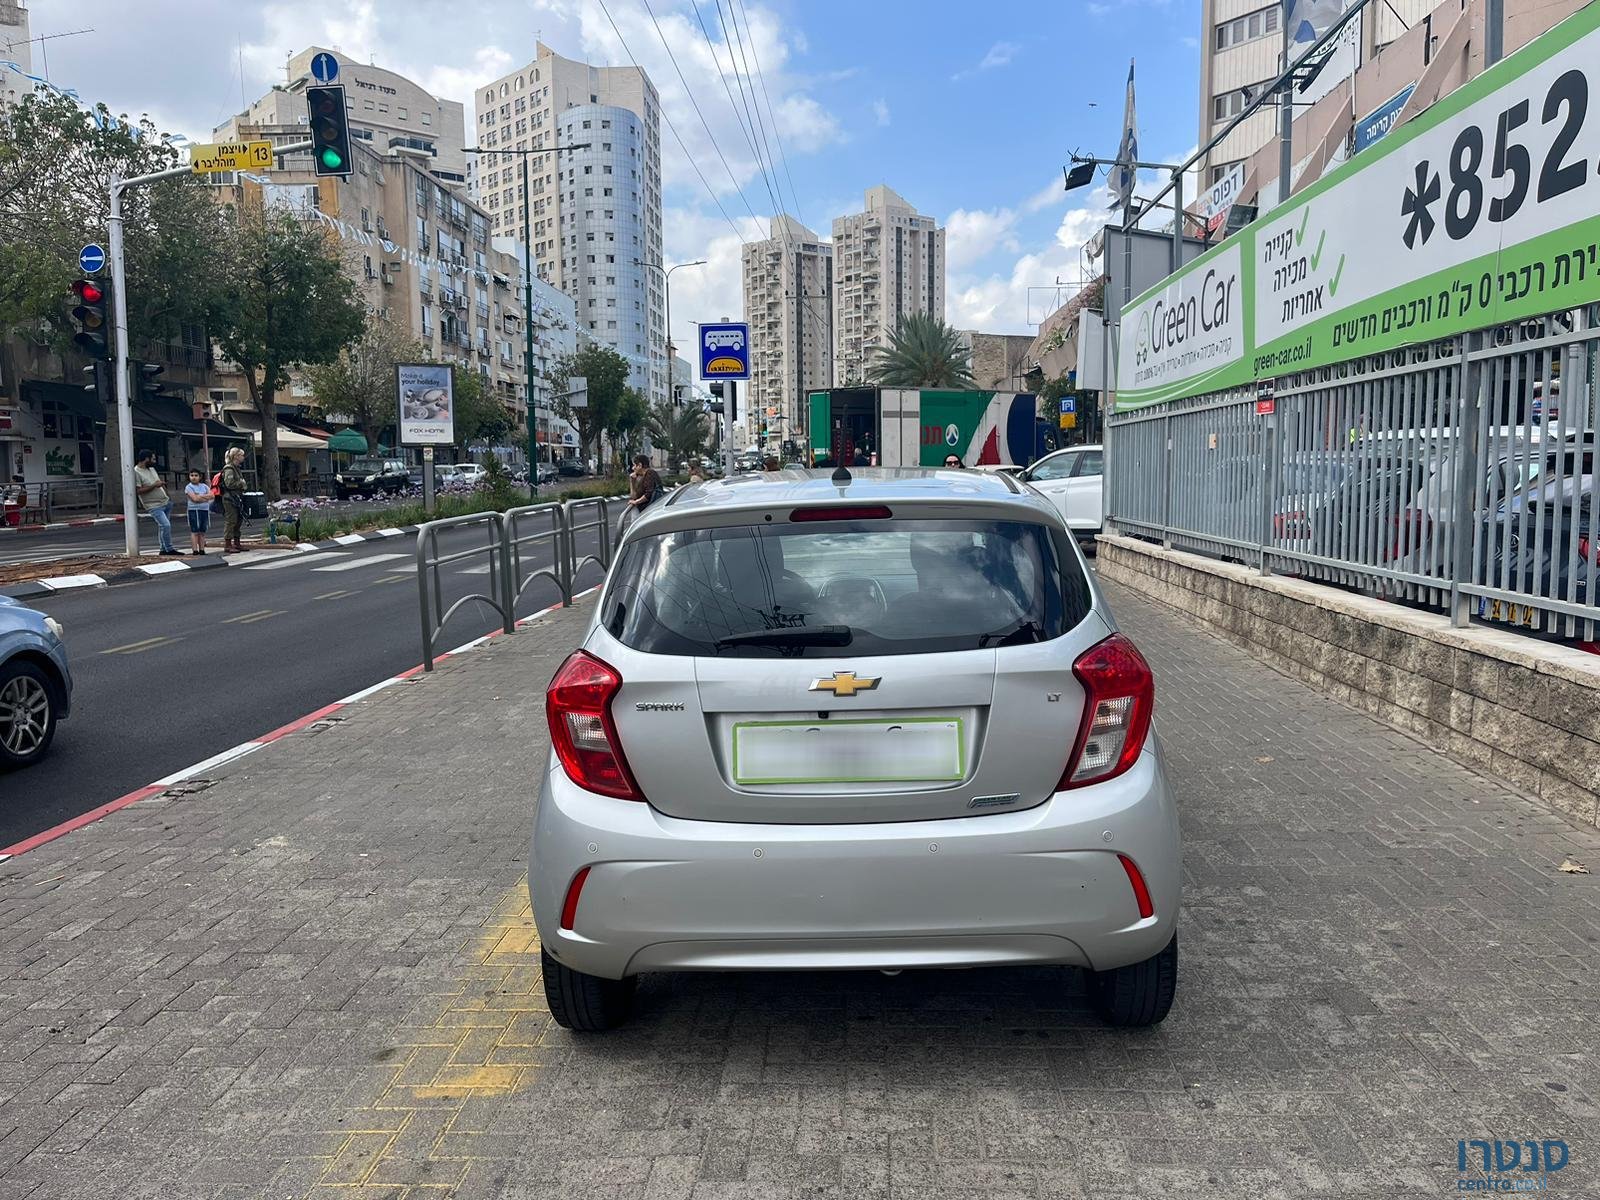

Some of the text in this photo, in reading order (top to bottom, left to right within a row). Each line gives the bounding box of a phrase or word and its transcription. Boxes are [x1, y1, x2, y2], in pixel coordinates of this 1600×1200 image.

[201, 156, 236, 168] מוהליבר
[218, 145, 241, 157] ויצמן
[254, 147, 268, 161] 13
[1401, 69, 1600, 250] 852
[1213, 172, 1237, 206] דפוס
[1264, 228, 1293, 263] קנייה
[1273, 256, 1307, 292] מכירה
[1479, 272, 1492, 309] 0
[1498, 261, 1545, 302] רכבי
[1152, 269, 1235, 354] Green Car
[1281, 285, 1324, 323] אחריות
[1381, 295, 1432, 334] ורכבים
[1332, 313, 1377, 348] חדשים
[1253, 335, 1312, 377] green-car.co.il
[636, 702, 685, 711] SPARK
[1047, 692, 1062, 702] LT
